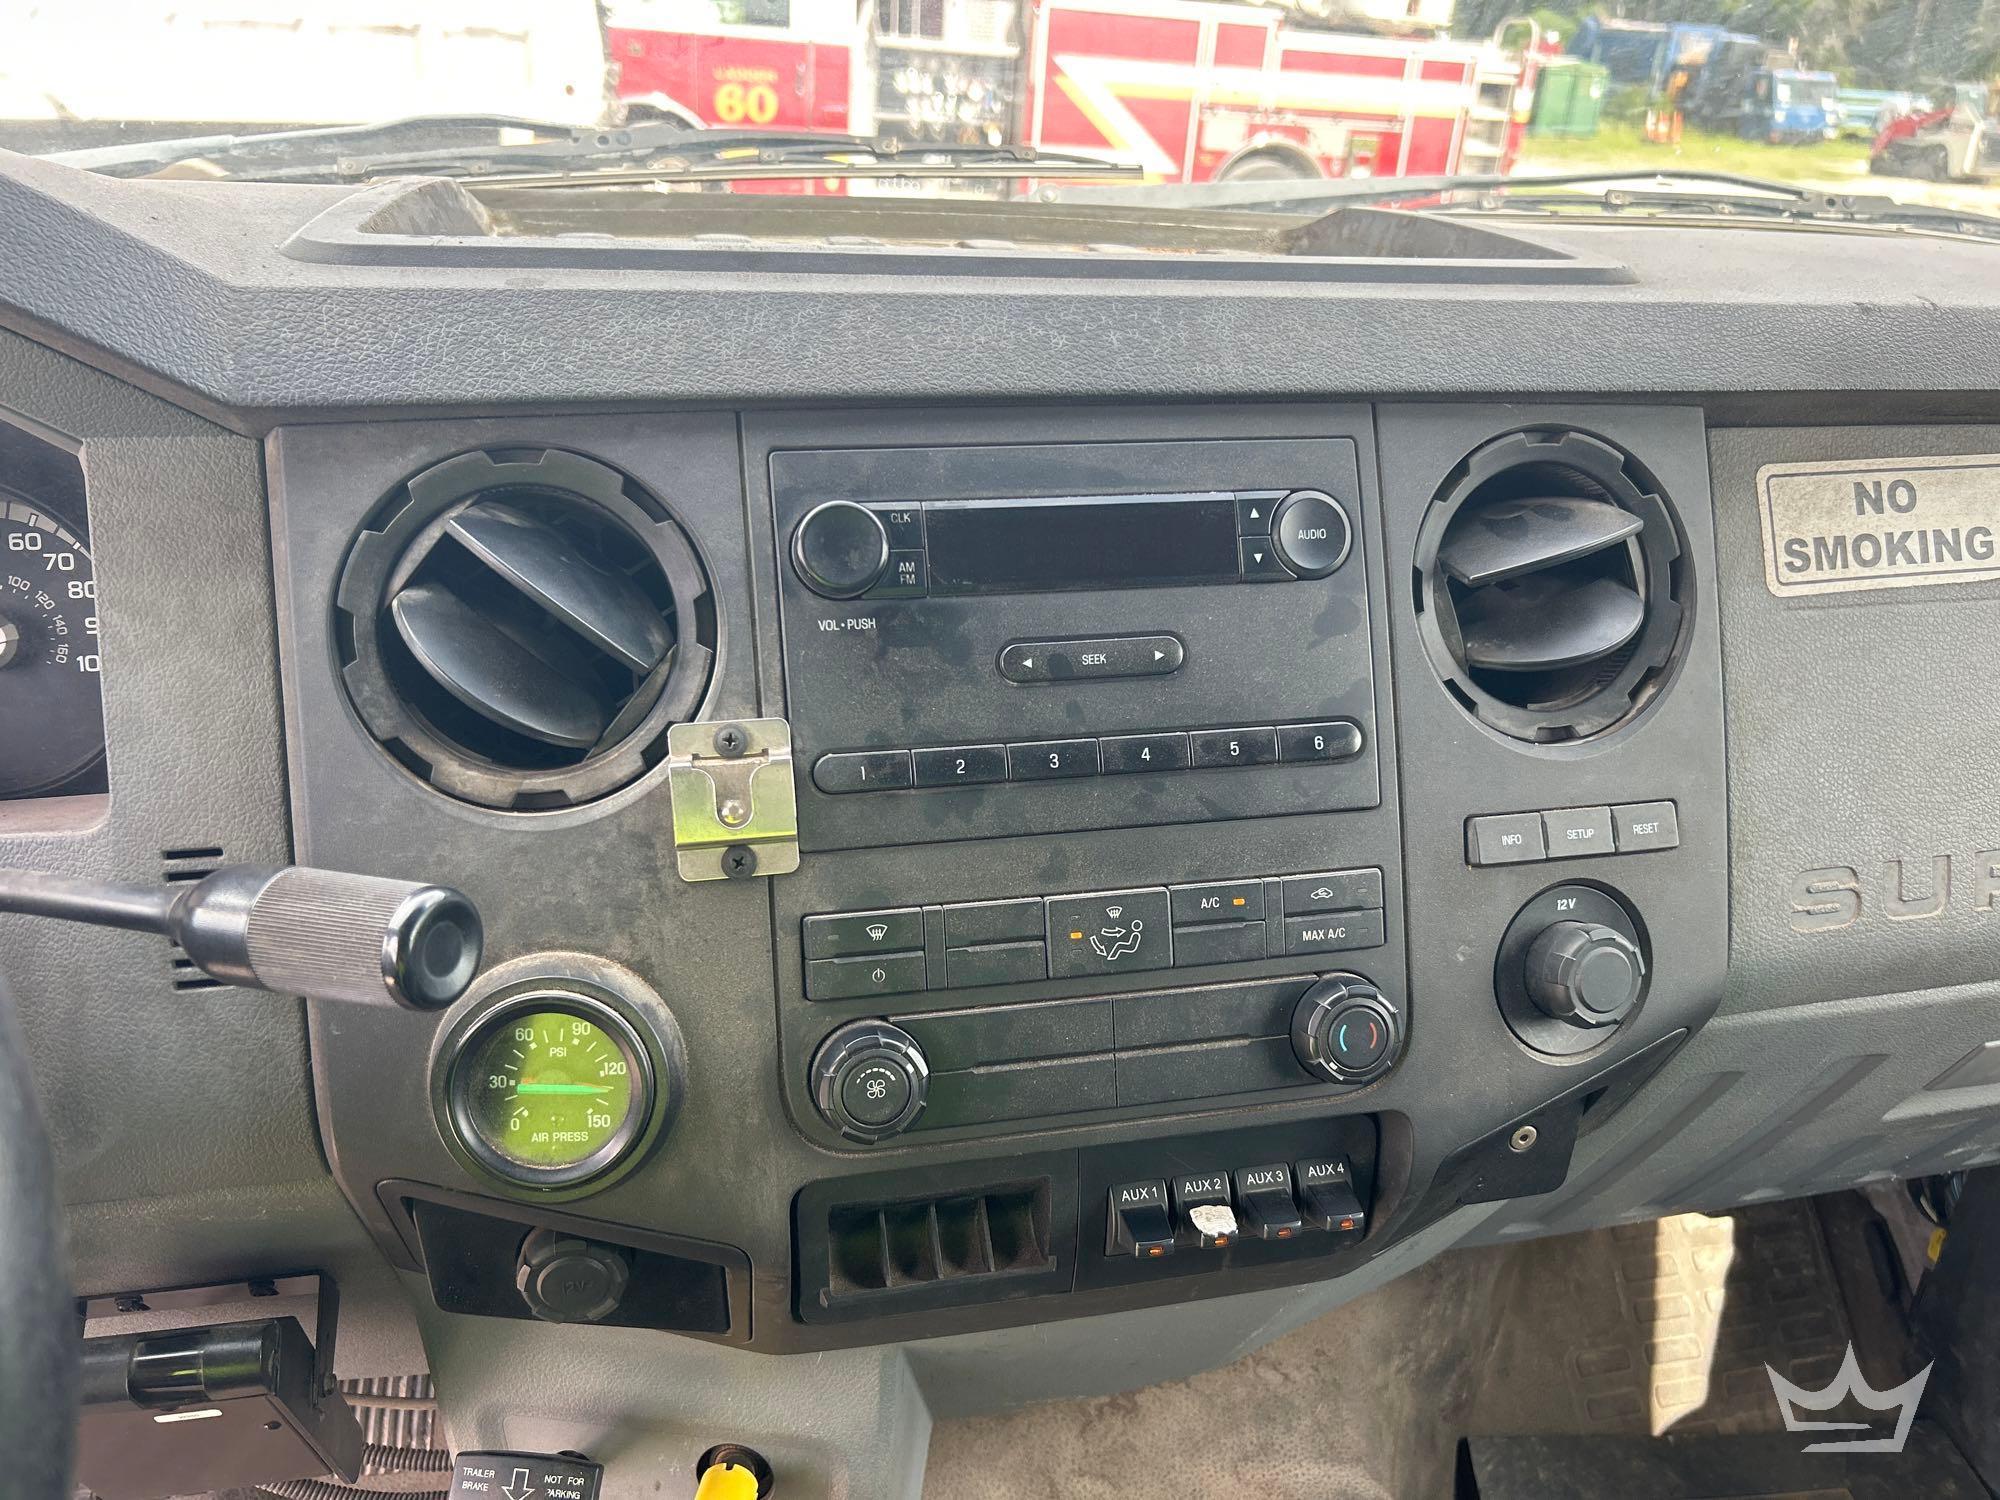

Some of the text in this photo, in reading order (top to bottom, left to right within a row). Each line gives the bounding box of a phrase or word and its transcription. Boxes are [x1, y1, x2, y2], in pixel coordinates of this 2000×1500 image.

[1853, 479, 1917, 516] NO
[890, 512, 911, 523] CLK
[8, 532, 42, 551] 60
[1297, 528, 1327, 541] AUDIO
[1783, 526, 1995, 574] SMOKING
[42, 552, 75, 571] 70
[898, 561, 916, 573] AM
[8, 575, 31, 591] 100
[900, 574, 916, 585] FM
[67, 581, 95, 599] 80
[35, 590, 55, 610] 120
[52, 615, 68, 636] 140
[55, 643, 69, 664] 160
[1081, 652, 1107, 666] SEEK
[1229, 741, 1239, 757] 5
[1313, 735, 1324, 751] 6
[1049, 753, 1060, 768] 3
[1141, 747, 1151, 763] 4
[860, 766, 867, 781] 1
[955, 759, 966, 775] 2
[1566, 828, 1595, 840] SETUP
[1632, 822, 1659, 835] RESET
[1501, 834, 1522, 846] INFO
[1200, 897, 1220, 909] A/C
[1556, 898, 1577, 911] 12V
[1302, 927, 1346, 942] MAX A/C
[515, 1028, 534, 1042] 60
[572, 1022, 591, 1036] 90
[549, 1047, 567, 1057] PSI
[604, 1062, 627, 1075] 120
[489, 1076, 508, 1089] 30
[510, 1117, 520, 1131] 0
[587, 1115, 611, 1128] 150
[531, 1131, 589, 1143] AIR PRESS
[1307, 1162, 1345, 1178] AUX 4
[1246, 1170, 1284, 1186] AUX 3
[1184, 1178, 1222, 1194] AUX 2
[1121, 1187, 1158, 1202] AUX 1
[463, 1467, 496, 1479] TRAILER
[544, 1474, 585, 1486] NOT FOR
[462, 1480, 489, 1492] BRAKE
[545, 1488, 581, 1500] PARKING
